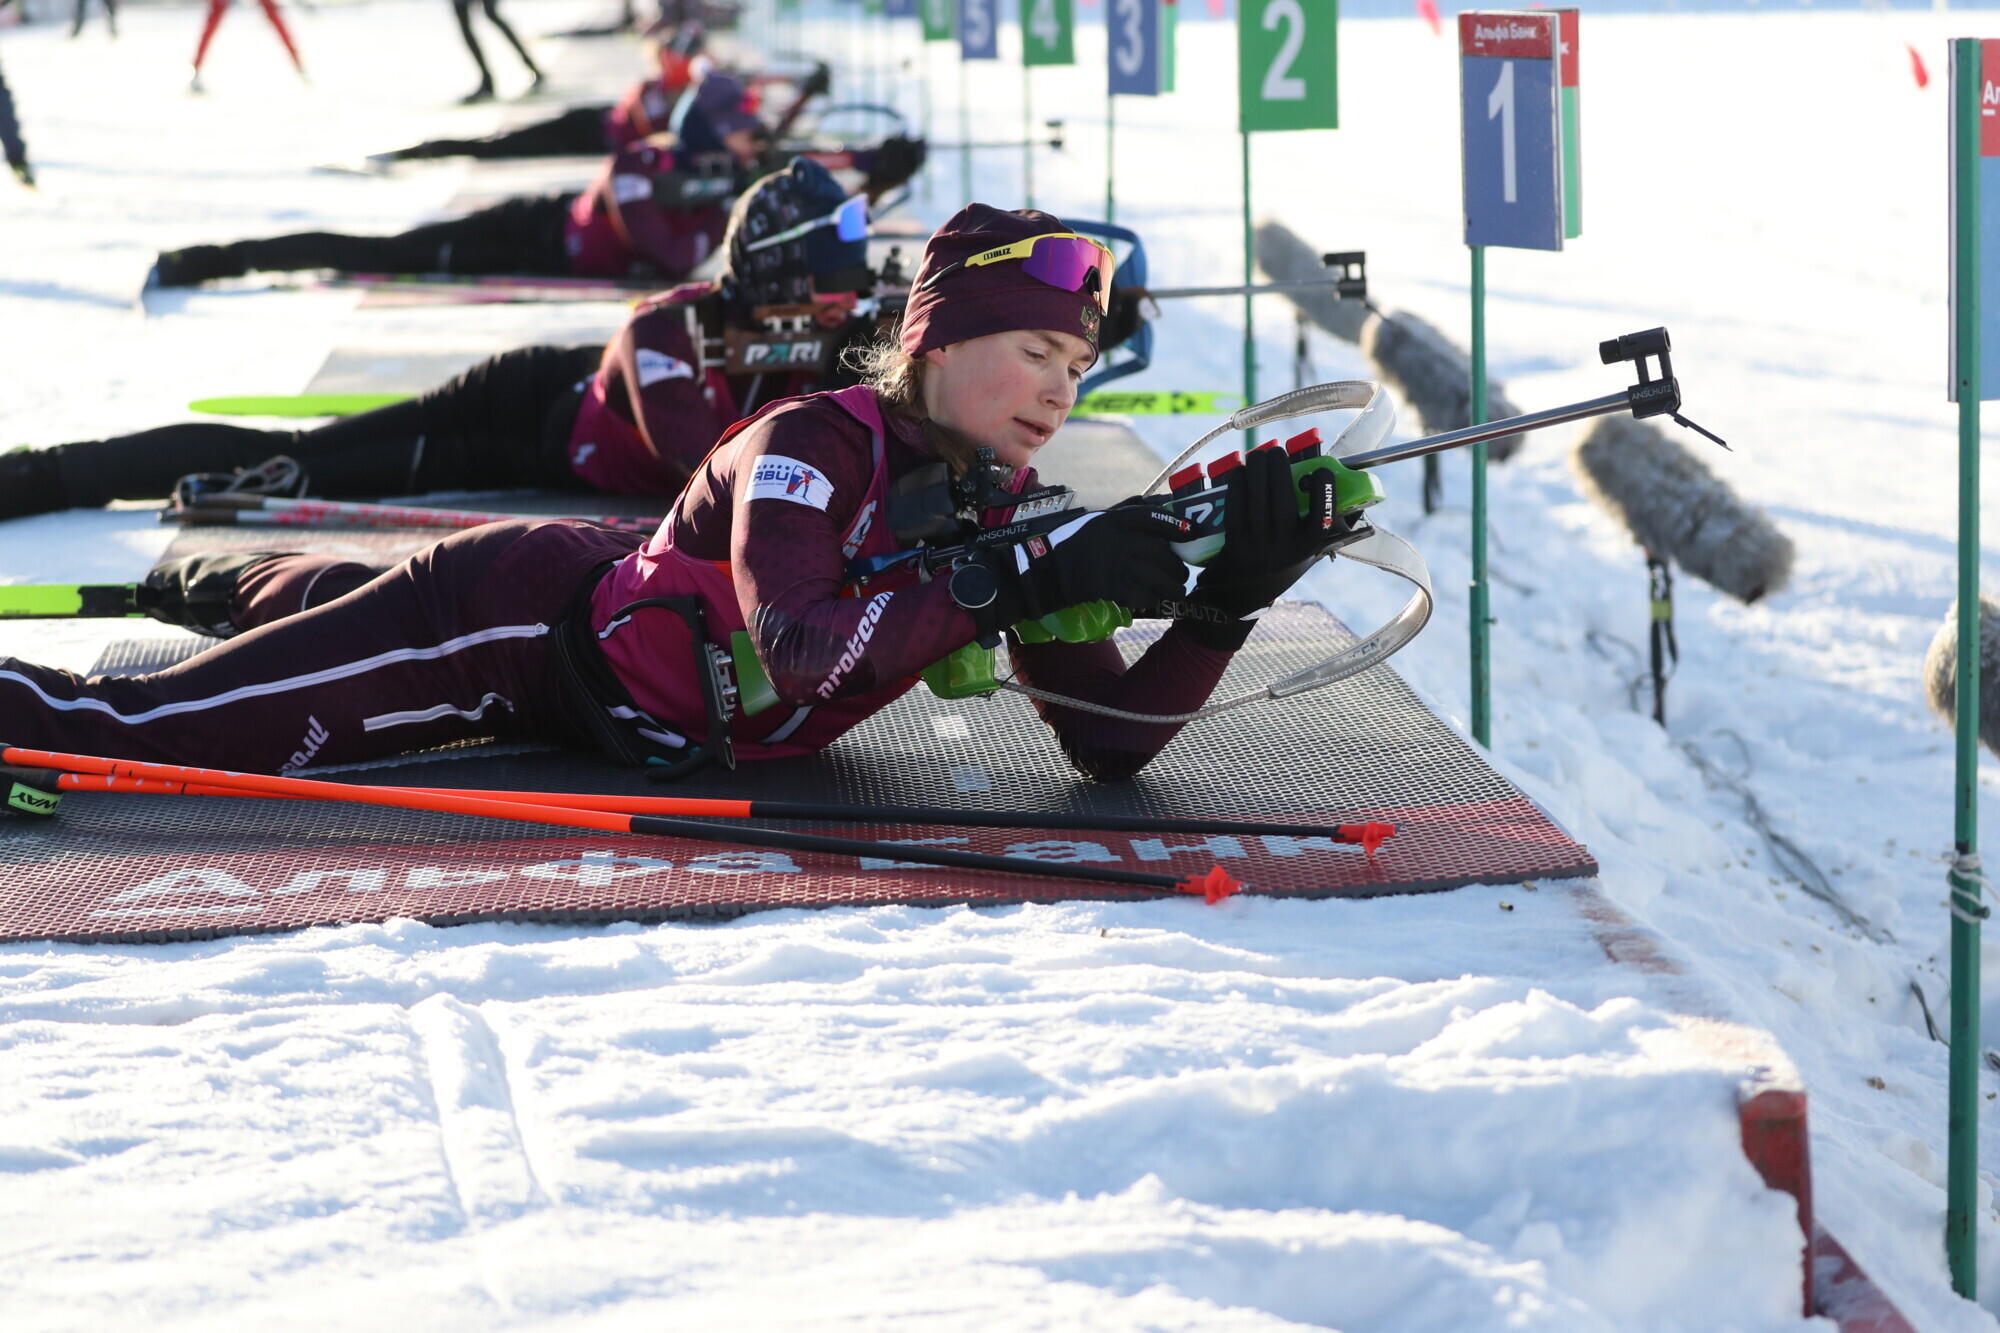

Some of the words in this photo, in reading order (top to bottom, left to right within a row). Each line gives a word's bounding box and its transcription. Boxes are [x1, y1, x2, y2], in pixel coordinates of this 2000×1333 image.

[1031, 0, 1059, 48] 4
[1114, 0, 1144, 76] 3
[1261, 0, 1306, 99] 2
[1488, 61, 1517, 203] 1
[976, 523, 1028, 543] ANSCHUTZ
